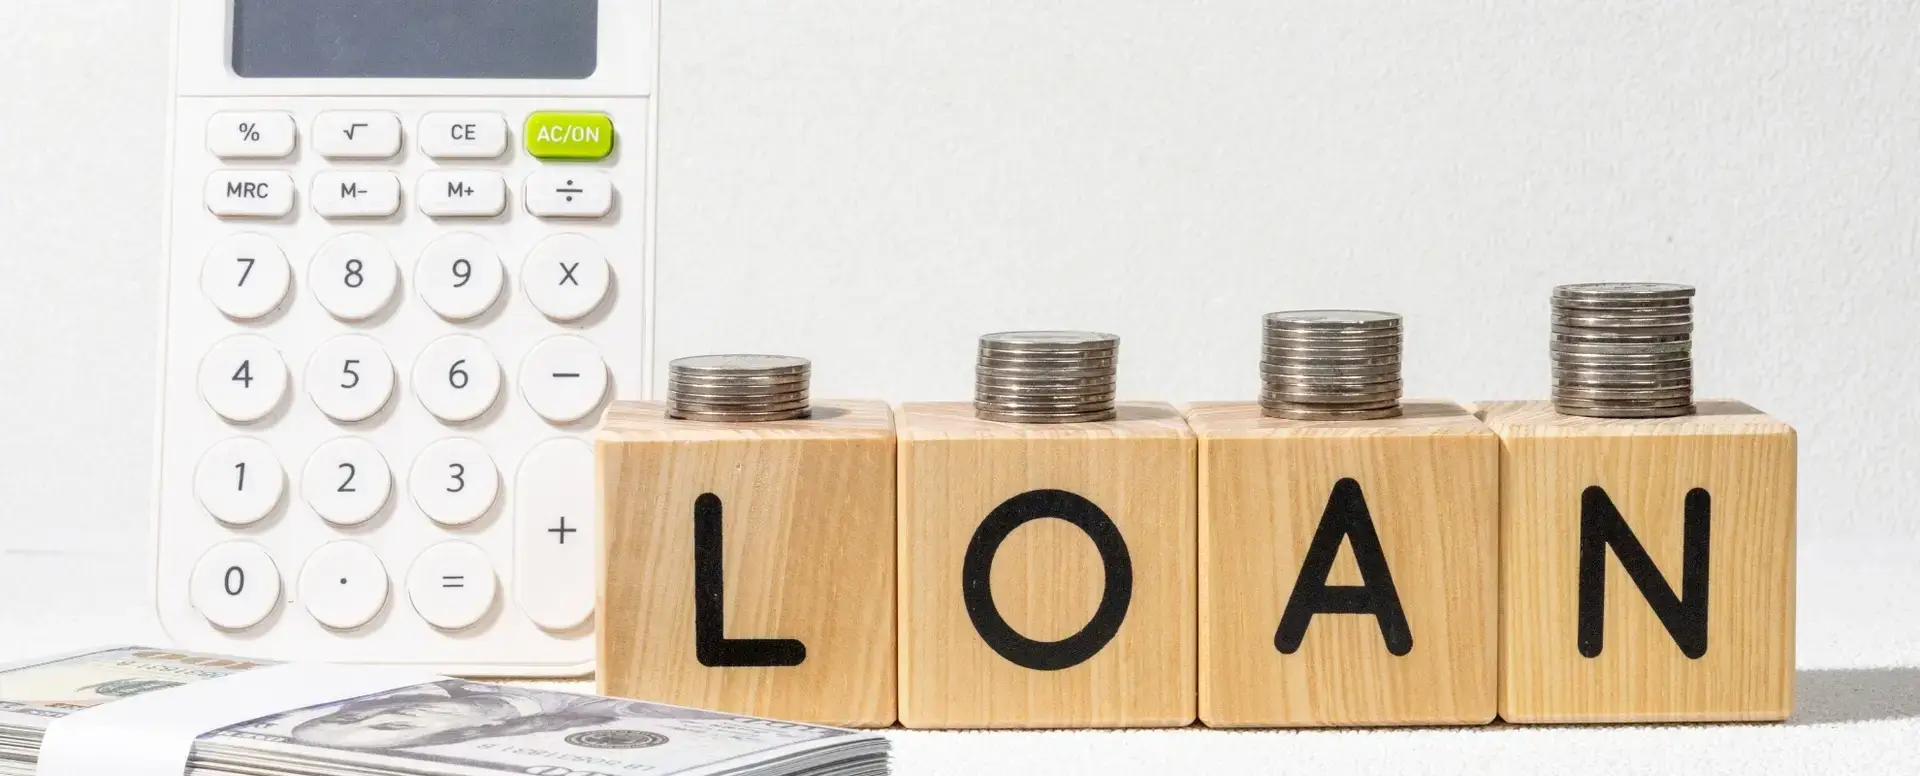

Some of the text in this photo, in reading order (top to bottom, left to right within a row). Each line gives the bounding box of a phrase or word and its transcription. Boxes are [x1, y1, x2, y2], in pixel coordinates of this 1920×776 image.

[239, 122, 260, 141] %
[451, 124, 476, 140] CE
[536, 125, 600, 143] AC/ON
[227, 182, 269, 199] MRC
[448, 181, 475, 197] M+
[237, 258, 255, 287] 7
[344, 259, 364, 288] 8
[452, 258, 472, 288] 9
[231, 359, 254, 389] 4
[340, 359, 360, 389] 5
[449, 359, 469, 389] 6
[235, 462, 246, 491] 1
[337, 463, 356, 493] 2
[446, 463, 465, 493] 3
[224, 566, 245, 596] 0
